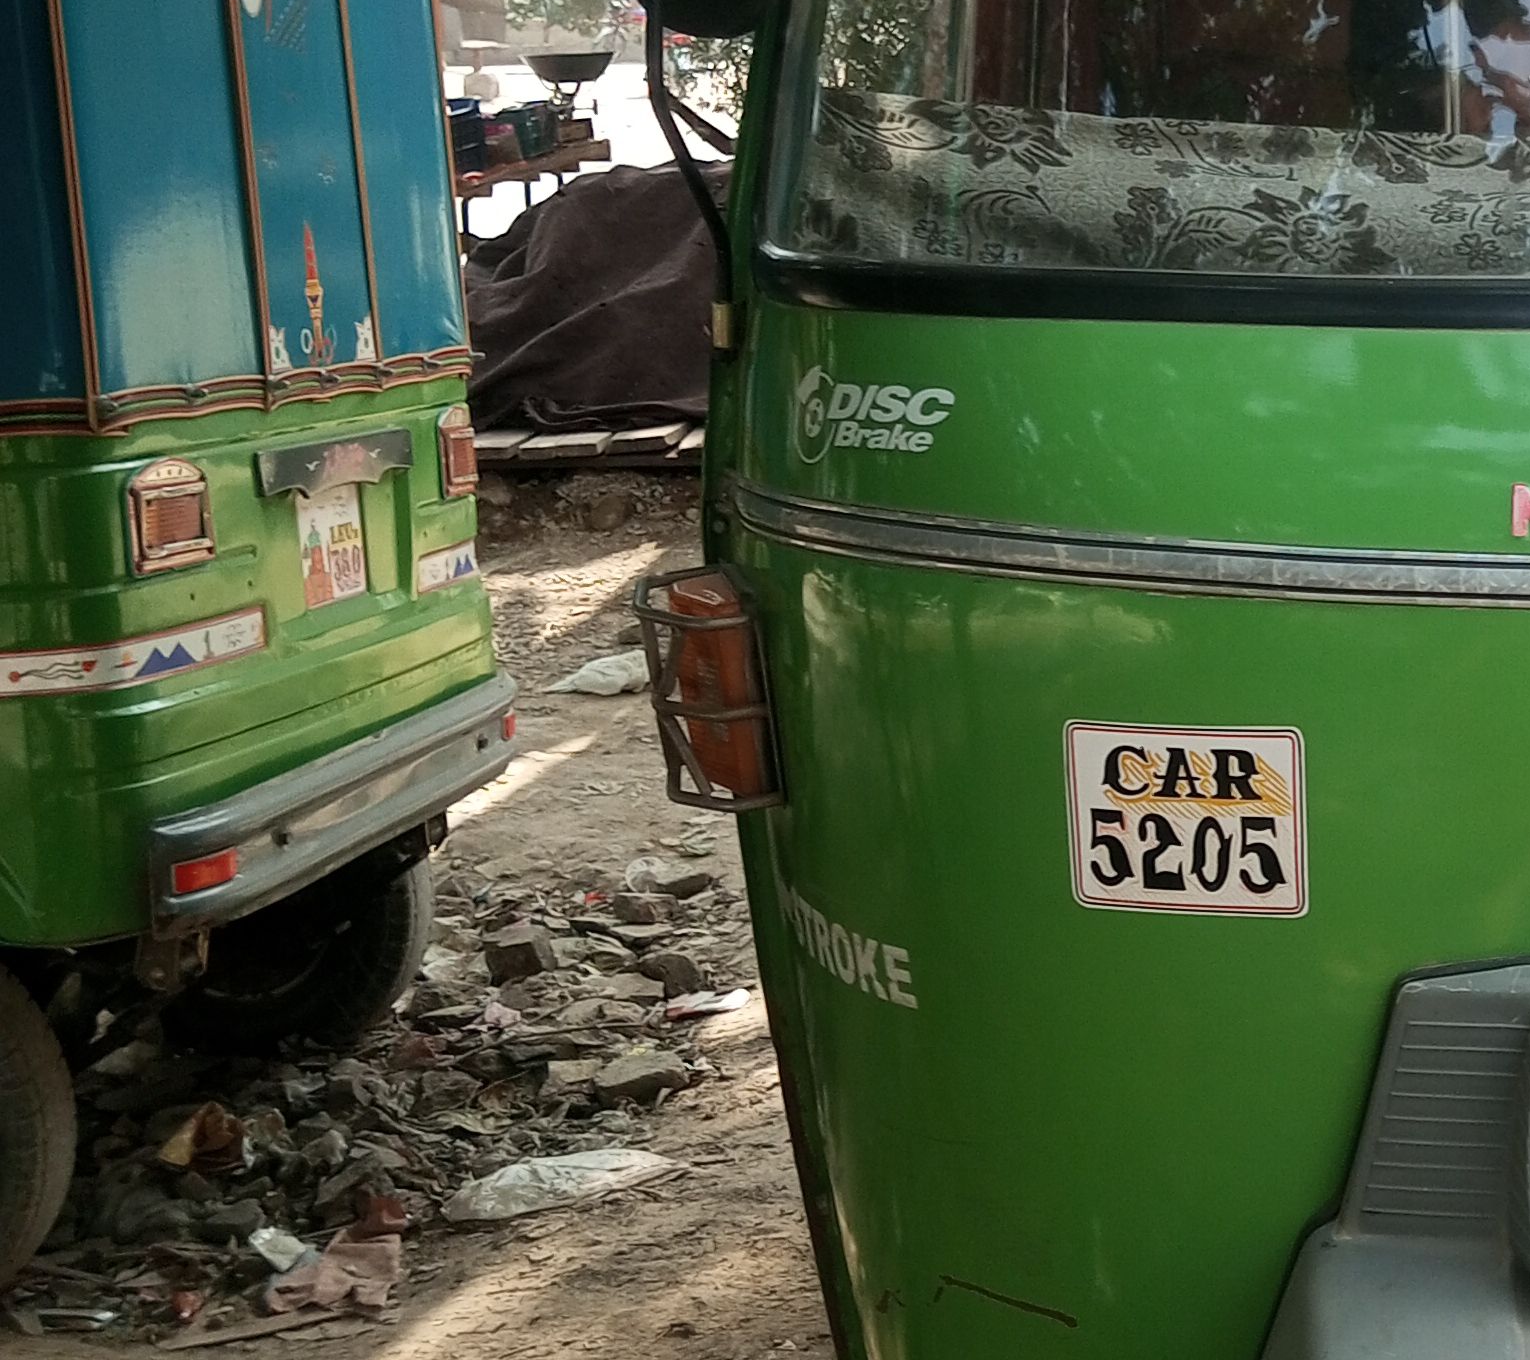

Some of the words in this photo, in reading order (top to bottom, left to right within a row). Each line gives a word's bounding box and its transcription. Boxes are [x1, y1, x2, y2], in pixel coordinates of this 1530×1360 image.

[827, 383, 955, 426] DISC
[834, 421, 934, 453] Brake
[1102, 745, 1264, 801] CAR
[1090, 808, 1287, 894] 5205
